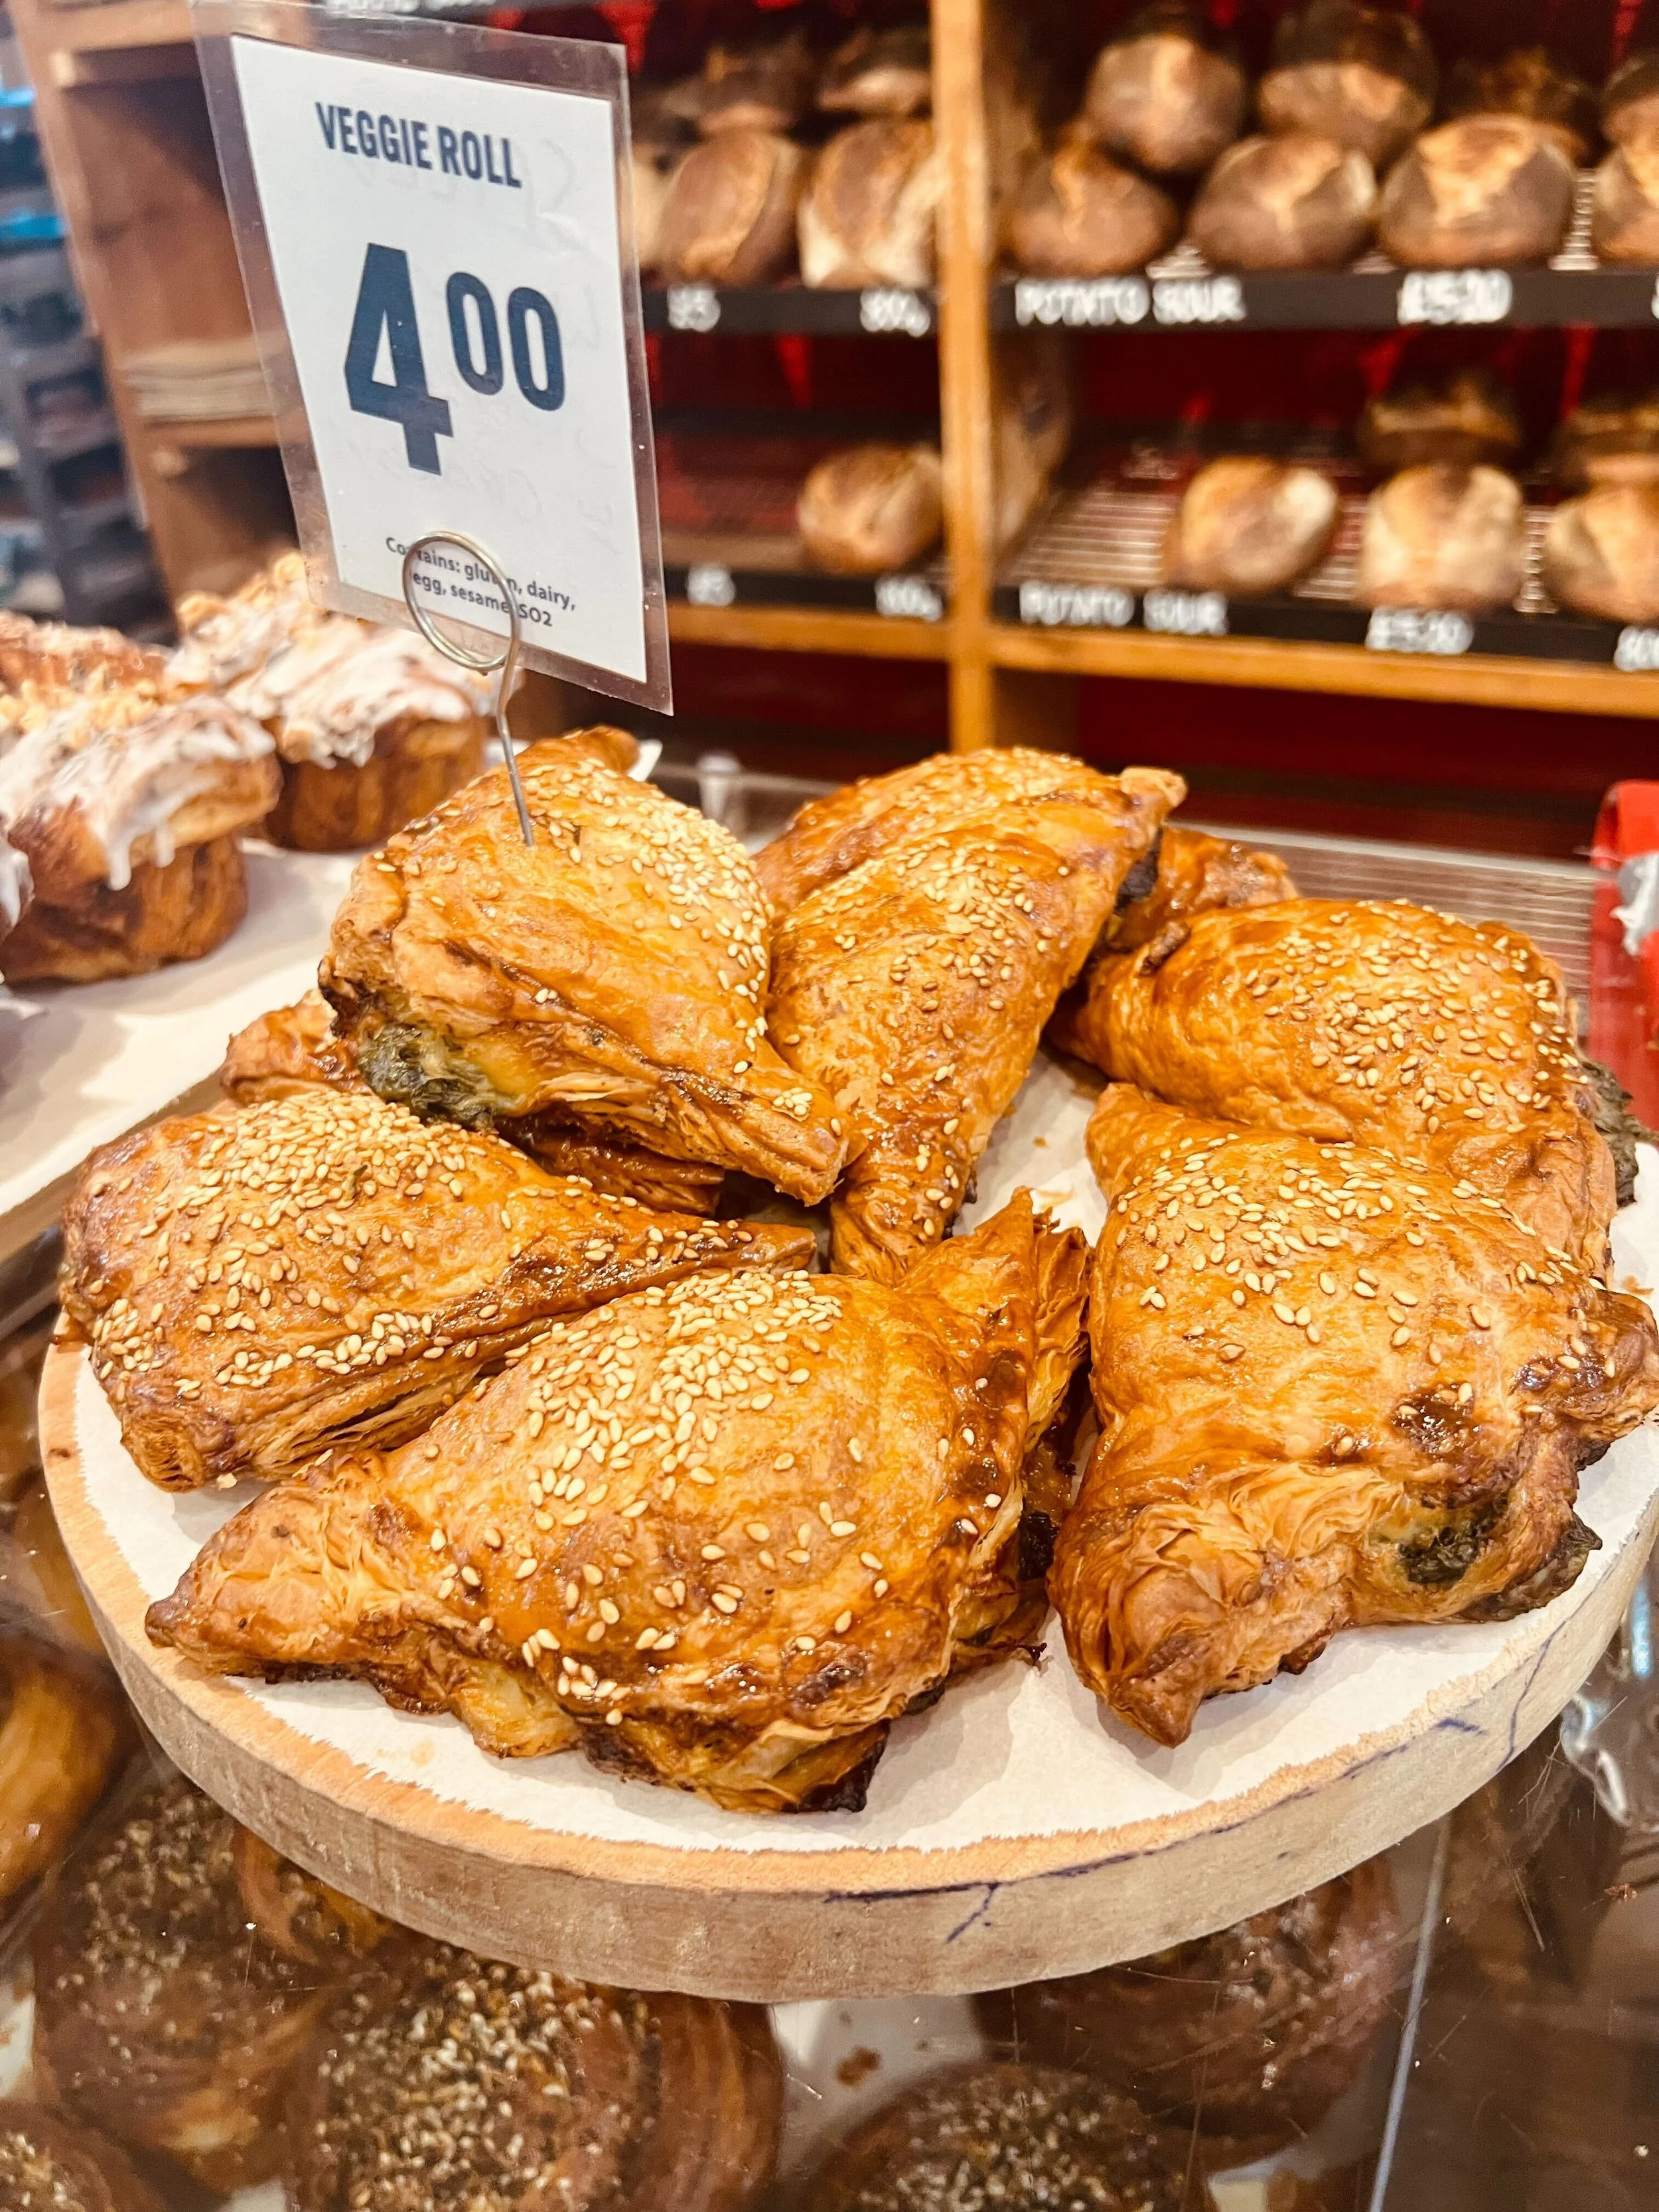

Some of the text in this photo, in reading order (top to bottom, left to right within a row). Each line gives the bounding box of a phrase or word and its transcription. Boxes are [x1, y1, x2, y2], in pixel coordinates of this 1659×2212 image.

[315, 101, 522, 188] VEGGIE ROLL
[386, 536, 461, 573] Cotains:
[526, 580, 576, 611] dairy,
[412, 571, 447, 597] egg,
[518, 603, 553, 627] SO2
